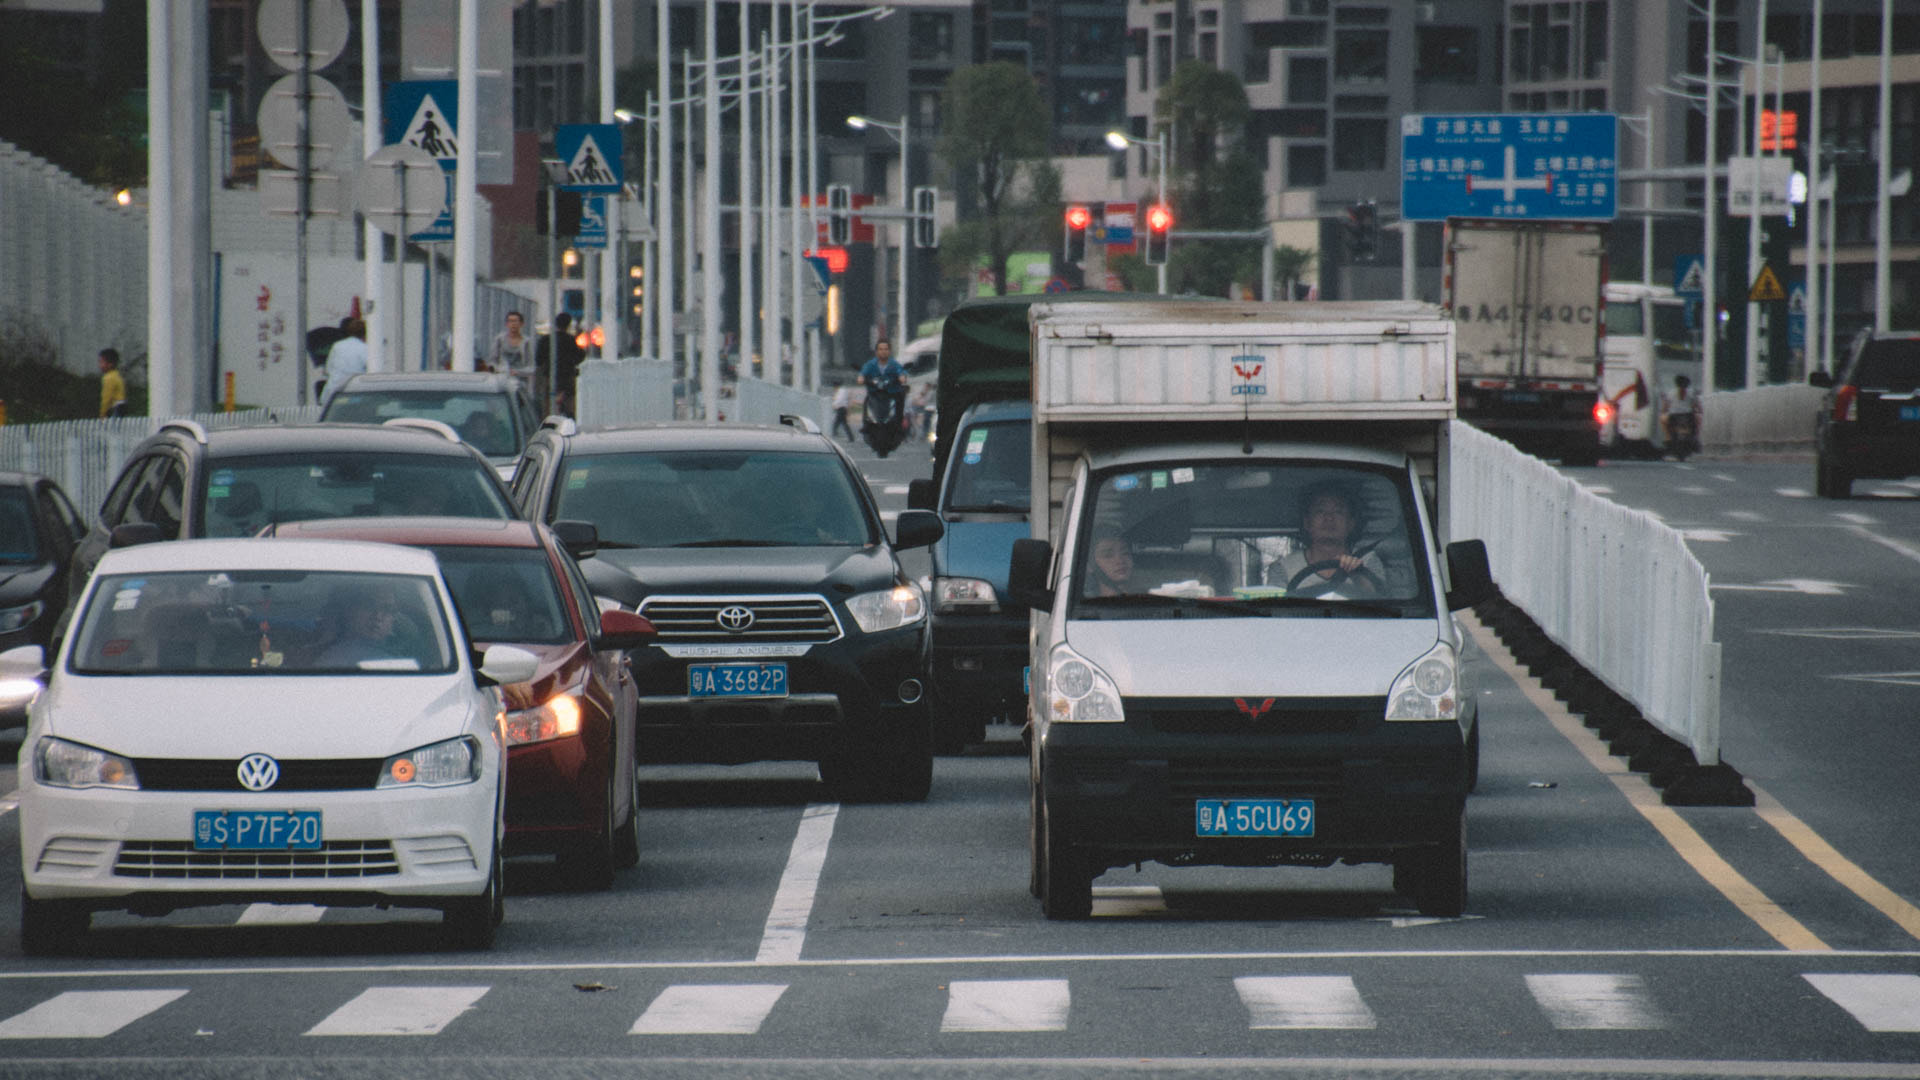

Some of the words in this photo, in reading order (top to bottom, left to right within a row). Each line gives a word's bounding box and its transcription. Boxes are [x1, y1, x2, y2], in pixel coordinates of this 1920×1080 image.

[679, 646, 795, 656] HIGHLANDER
[197, 815, 319, 844] 粤S·P7F20
[1199, 805, 1313, 832] 粤A·5CU69
